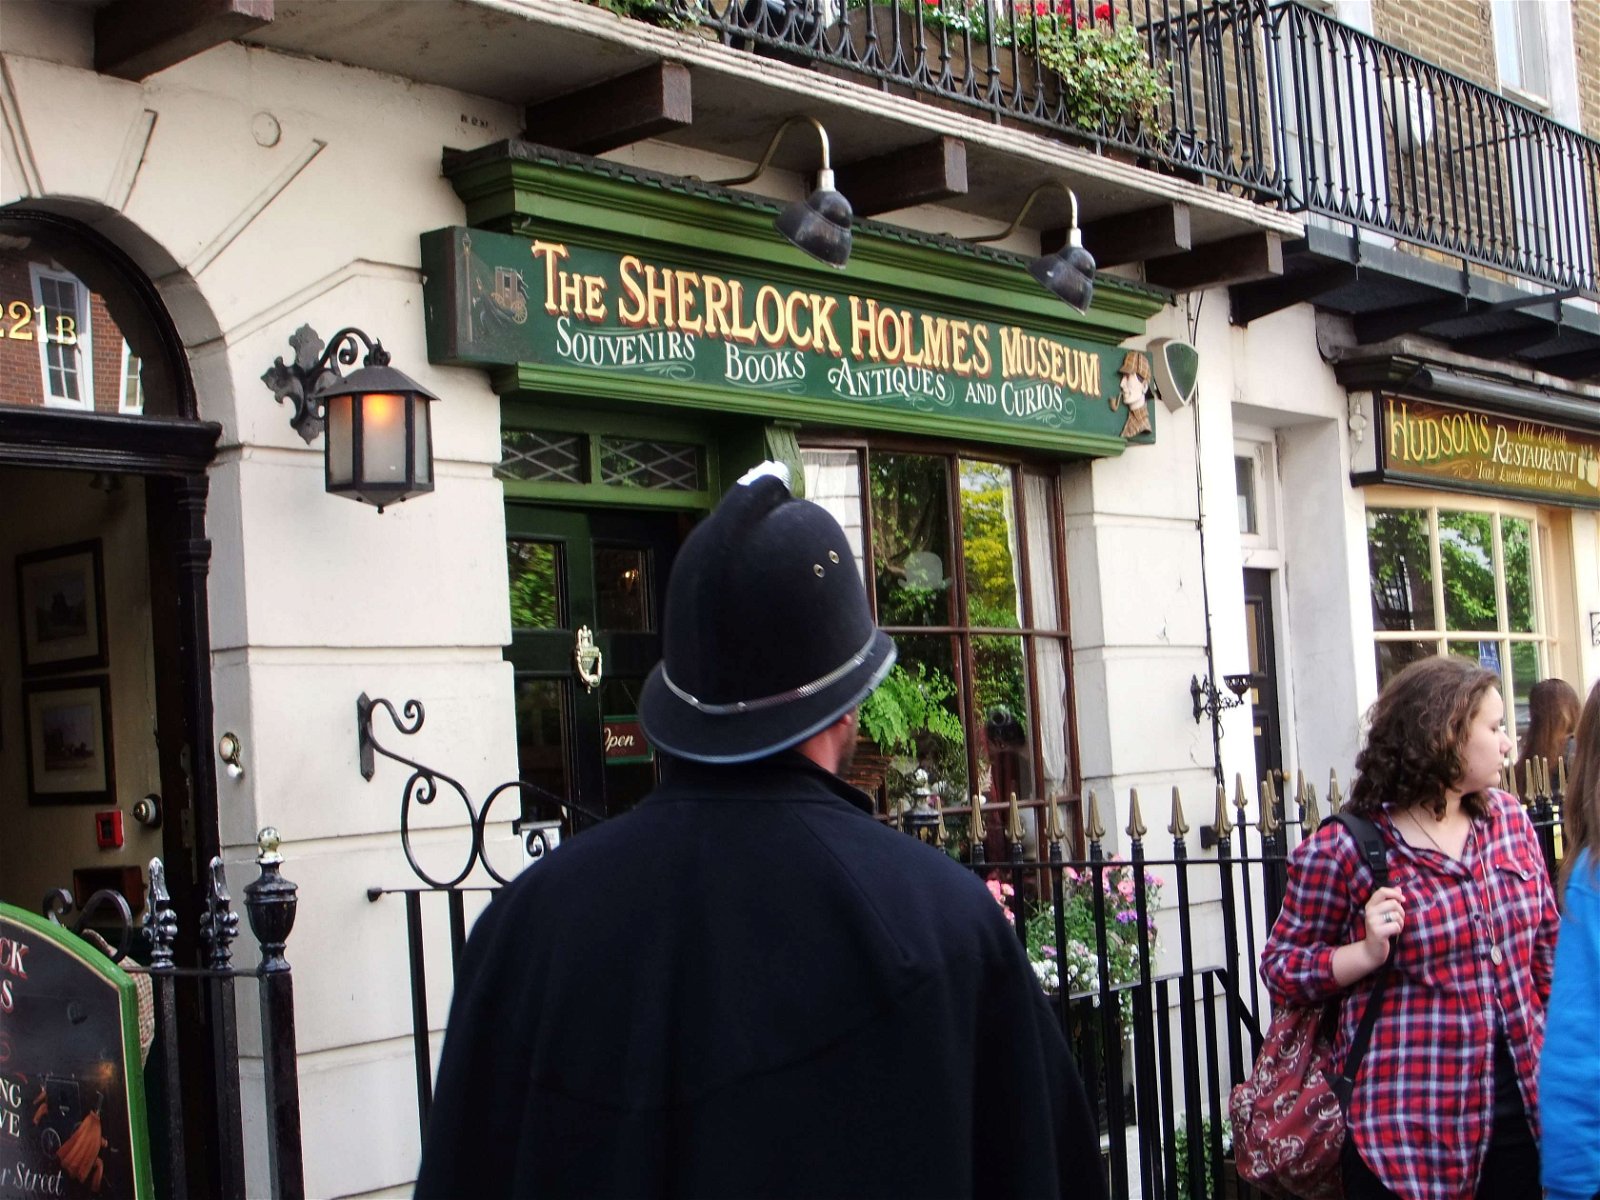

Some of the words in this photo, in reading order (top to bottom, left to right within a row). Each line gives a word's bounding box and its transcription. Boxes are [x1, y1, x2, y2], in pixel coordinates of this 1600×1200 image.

[531, 239, 607, 321] THE
[618, 255, 842, 357] SHERLOCK
[849, 295, 991, 378] HOLMES
[1000, 326, 1100, 397] MUSEUM
[557, 317, 695, 366] SOUVENIRS
[724, 341, 806, 384] BOOKS
[827, 357, 946, 401] ANTIQUES
[965, 382, 996, 405] AND
[1000, 381, 1063, 417] CURIOS
[1389, 400, 1491, 462] HUDSONS
[1492, 424, 1577, 474] RESTAURANT
[14, 1160, 63, 1197] Street
